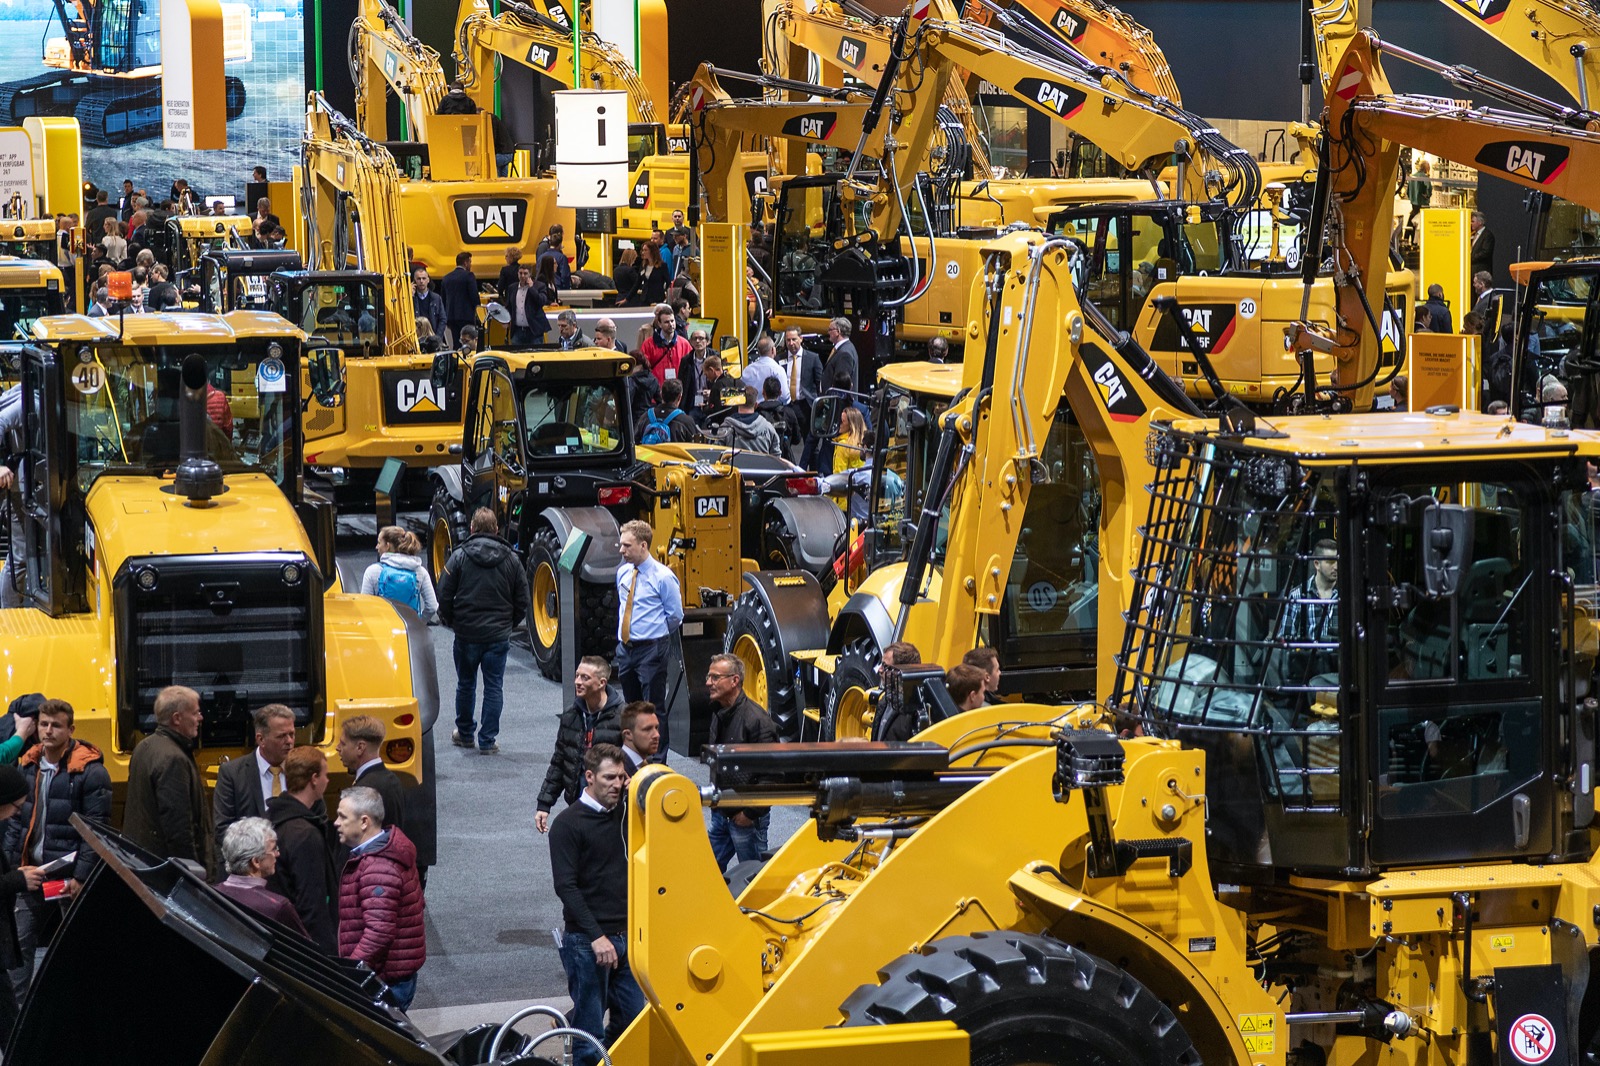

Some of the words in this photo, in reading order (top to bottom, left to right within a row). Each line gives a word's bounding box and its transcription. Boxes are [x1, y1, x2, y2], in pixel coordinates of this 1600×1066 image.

[1057, 11, 1078, 37] CAT
[532, 45, 550, 67] CAT
[842, 40, 859, 65] CAT
[1037, 82, 1069, 113] CAT
[597, 106, 606, 146] i
[801, 117, 824, 138] CAT
[1507, 145, 1546, 180] CAT
[597, 179, 608, 198] 2
[636, 184, 649, 197] CAT
[466, 205, 518, 238] CAT
[1288, 251, 1298, 263] 20
[948, 265, 958, 275] 20
[1241, 302, 1254, 314] 20
[1182, 308, 1212, 333] CAT
[79, 367, 99, 388] 40
[1094, 361, 1127, 408] CAT
[697, 497, 726, 517] CAT
